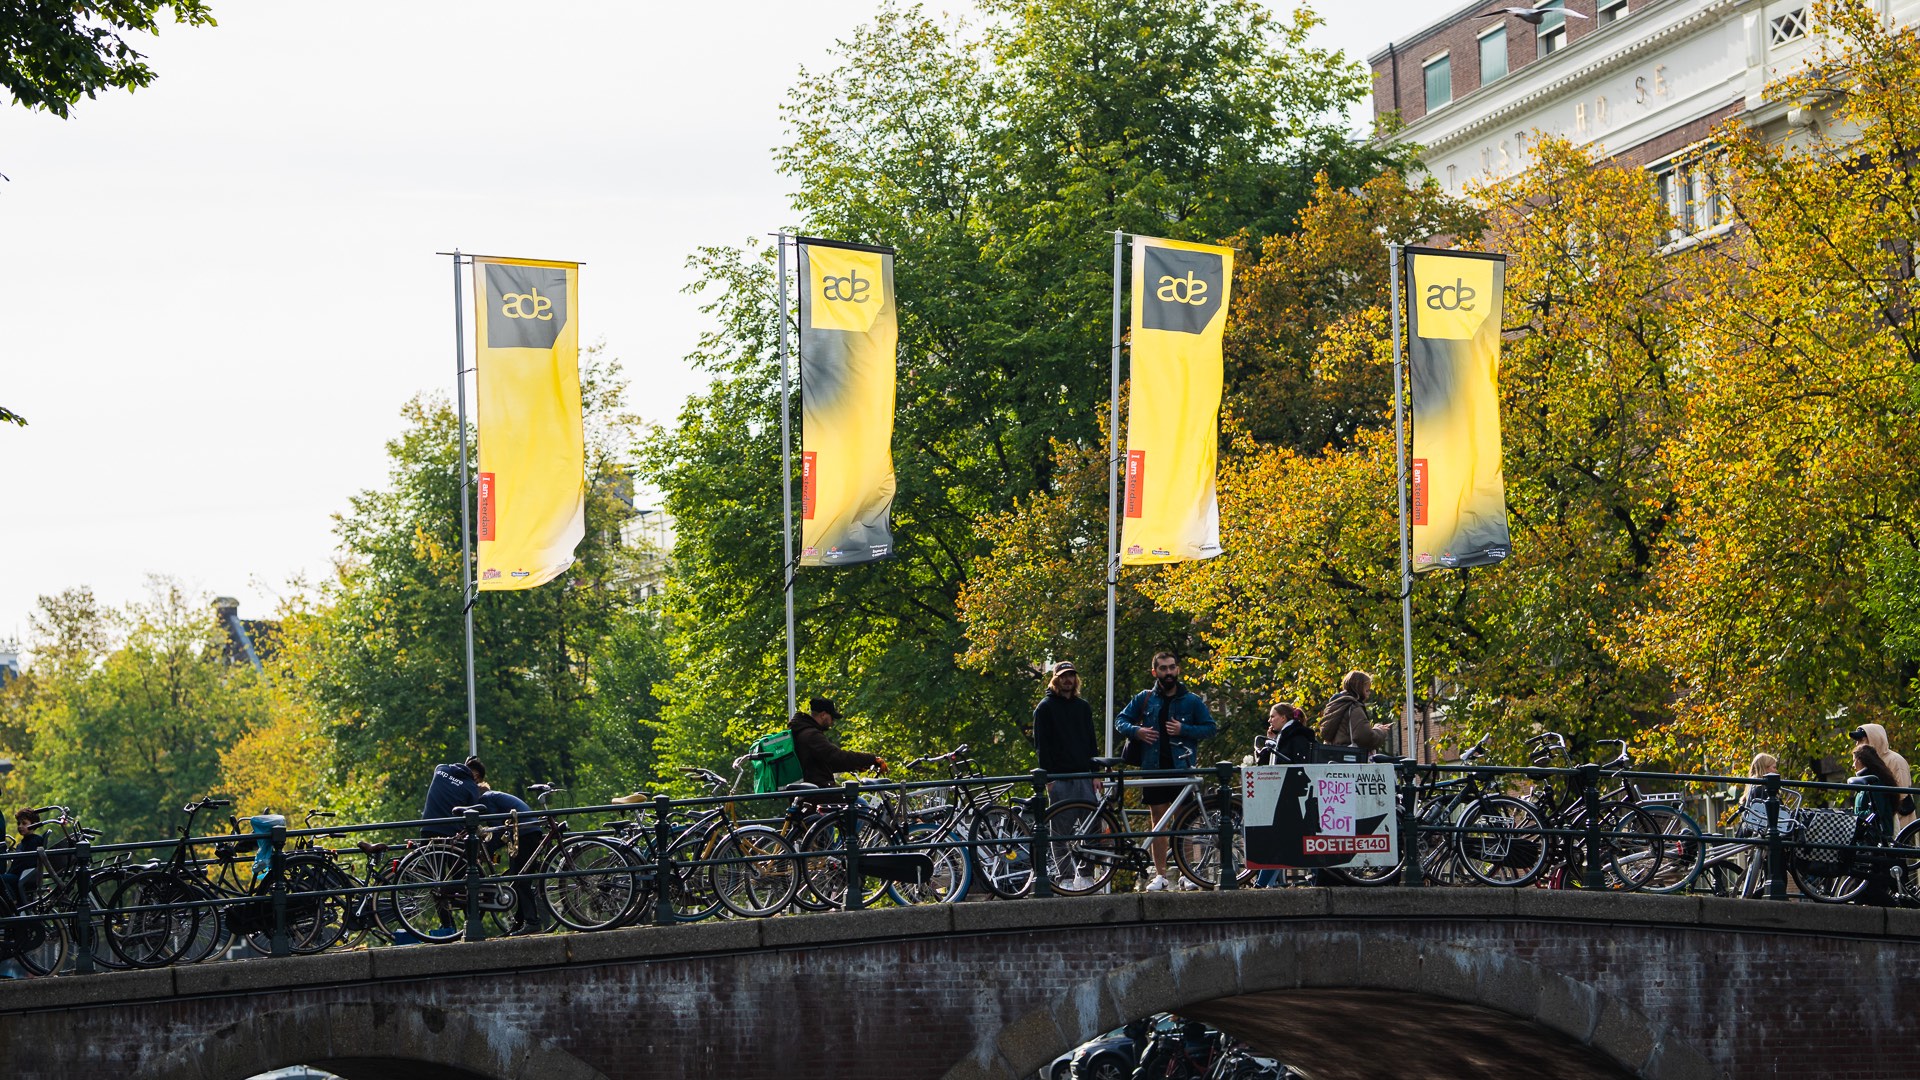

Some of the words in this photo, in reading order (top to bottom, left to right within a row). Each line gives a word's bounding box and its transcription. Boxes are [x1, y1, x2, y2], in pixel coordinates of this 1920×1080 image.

[1446, 130, 1526, 191] TUST
[1575, 63, 1667, 132] HOSE
[822, 269, 870, 303] ade
[1156, 270, 1208, 306] ade
[1426, 277, 1476, 312] ade
[501, 287, 553, 321] ade
[482, 483, 490, 536] amsterdam
[1414, 469, 1423, 521] amsterdam
[1322, 794, 1346, 804] WAS
[1323, 805, 1335, 815] A
[1320, 813, 1353, 832] RIOT
[1305, 838, 1354, 852] BOETE
[1355, 838, 1386, 849] €140
